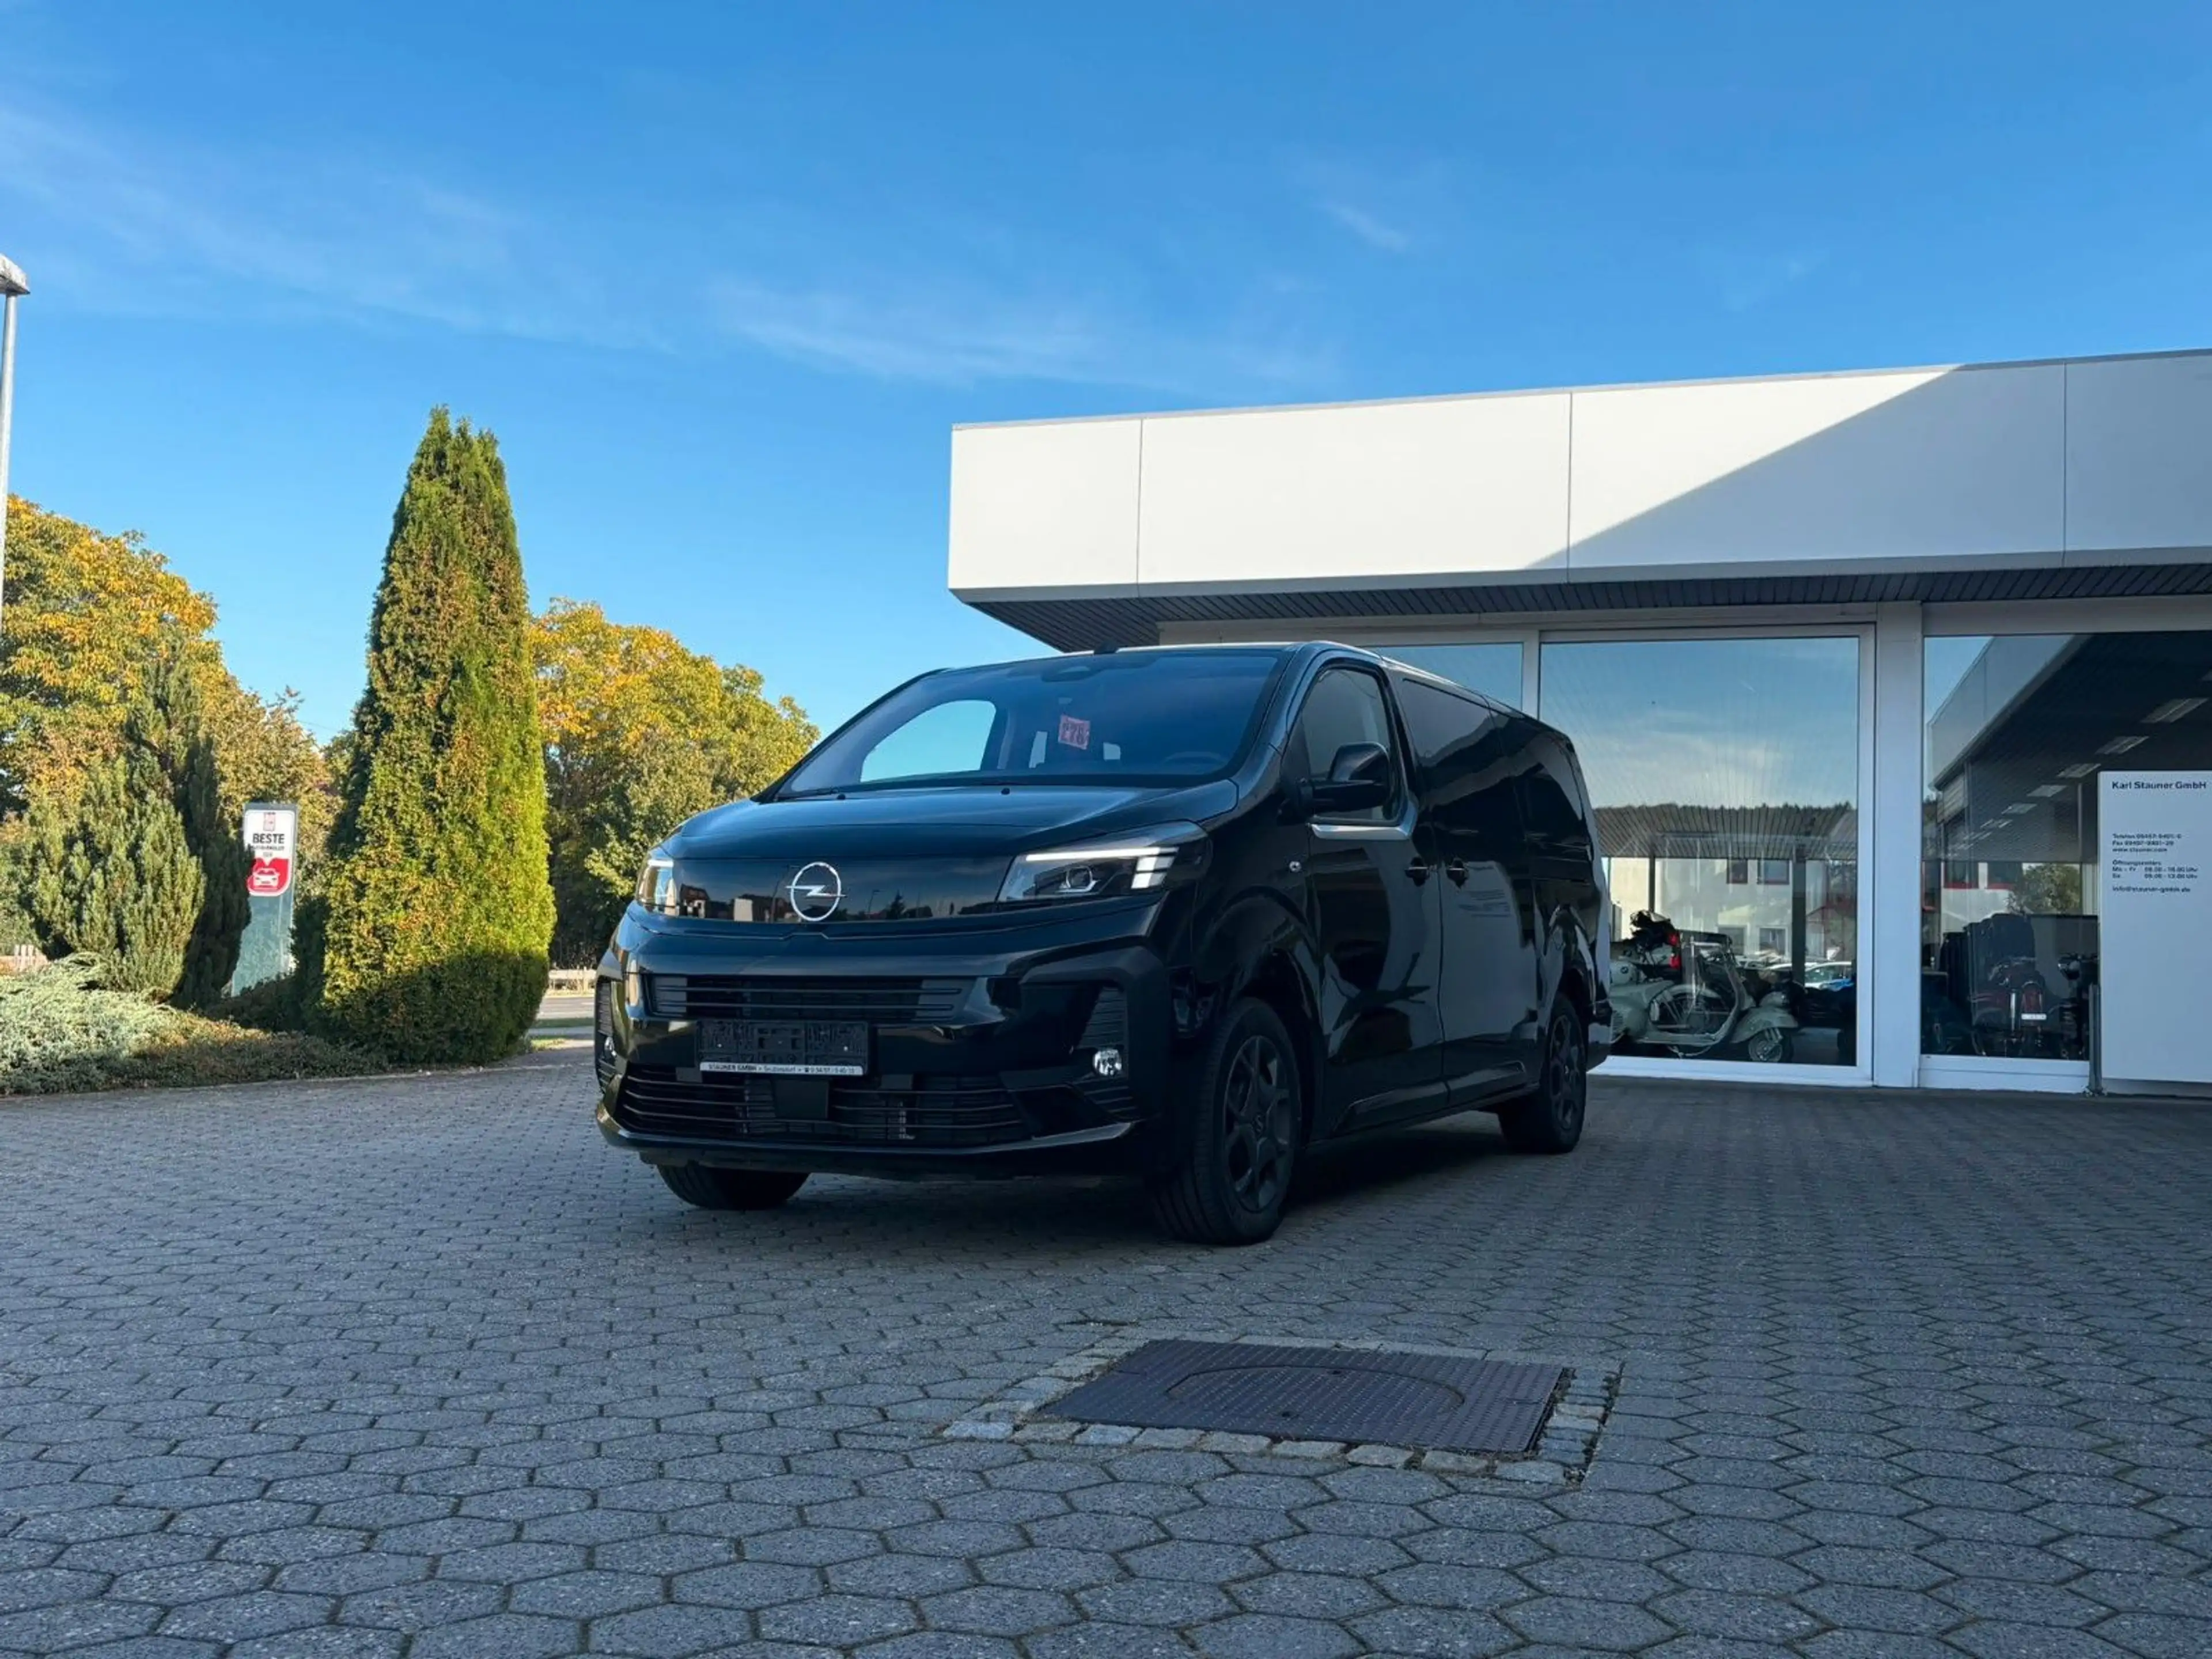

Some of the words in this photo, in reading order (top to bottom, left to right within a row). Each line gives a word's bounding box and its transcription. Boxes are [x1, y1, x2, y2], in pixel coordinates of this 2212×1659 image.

[2112, 781, 2131, 789] Karl
[2134, 781, 2173, 789] Stauner
[2175, 781, 2207, 789] GmbH
[253, 833, 285, 844] BESTE
